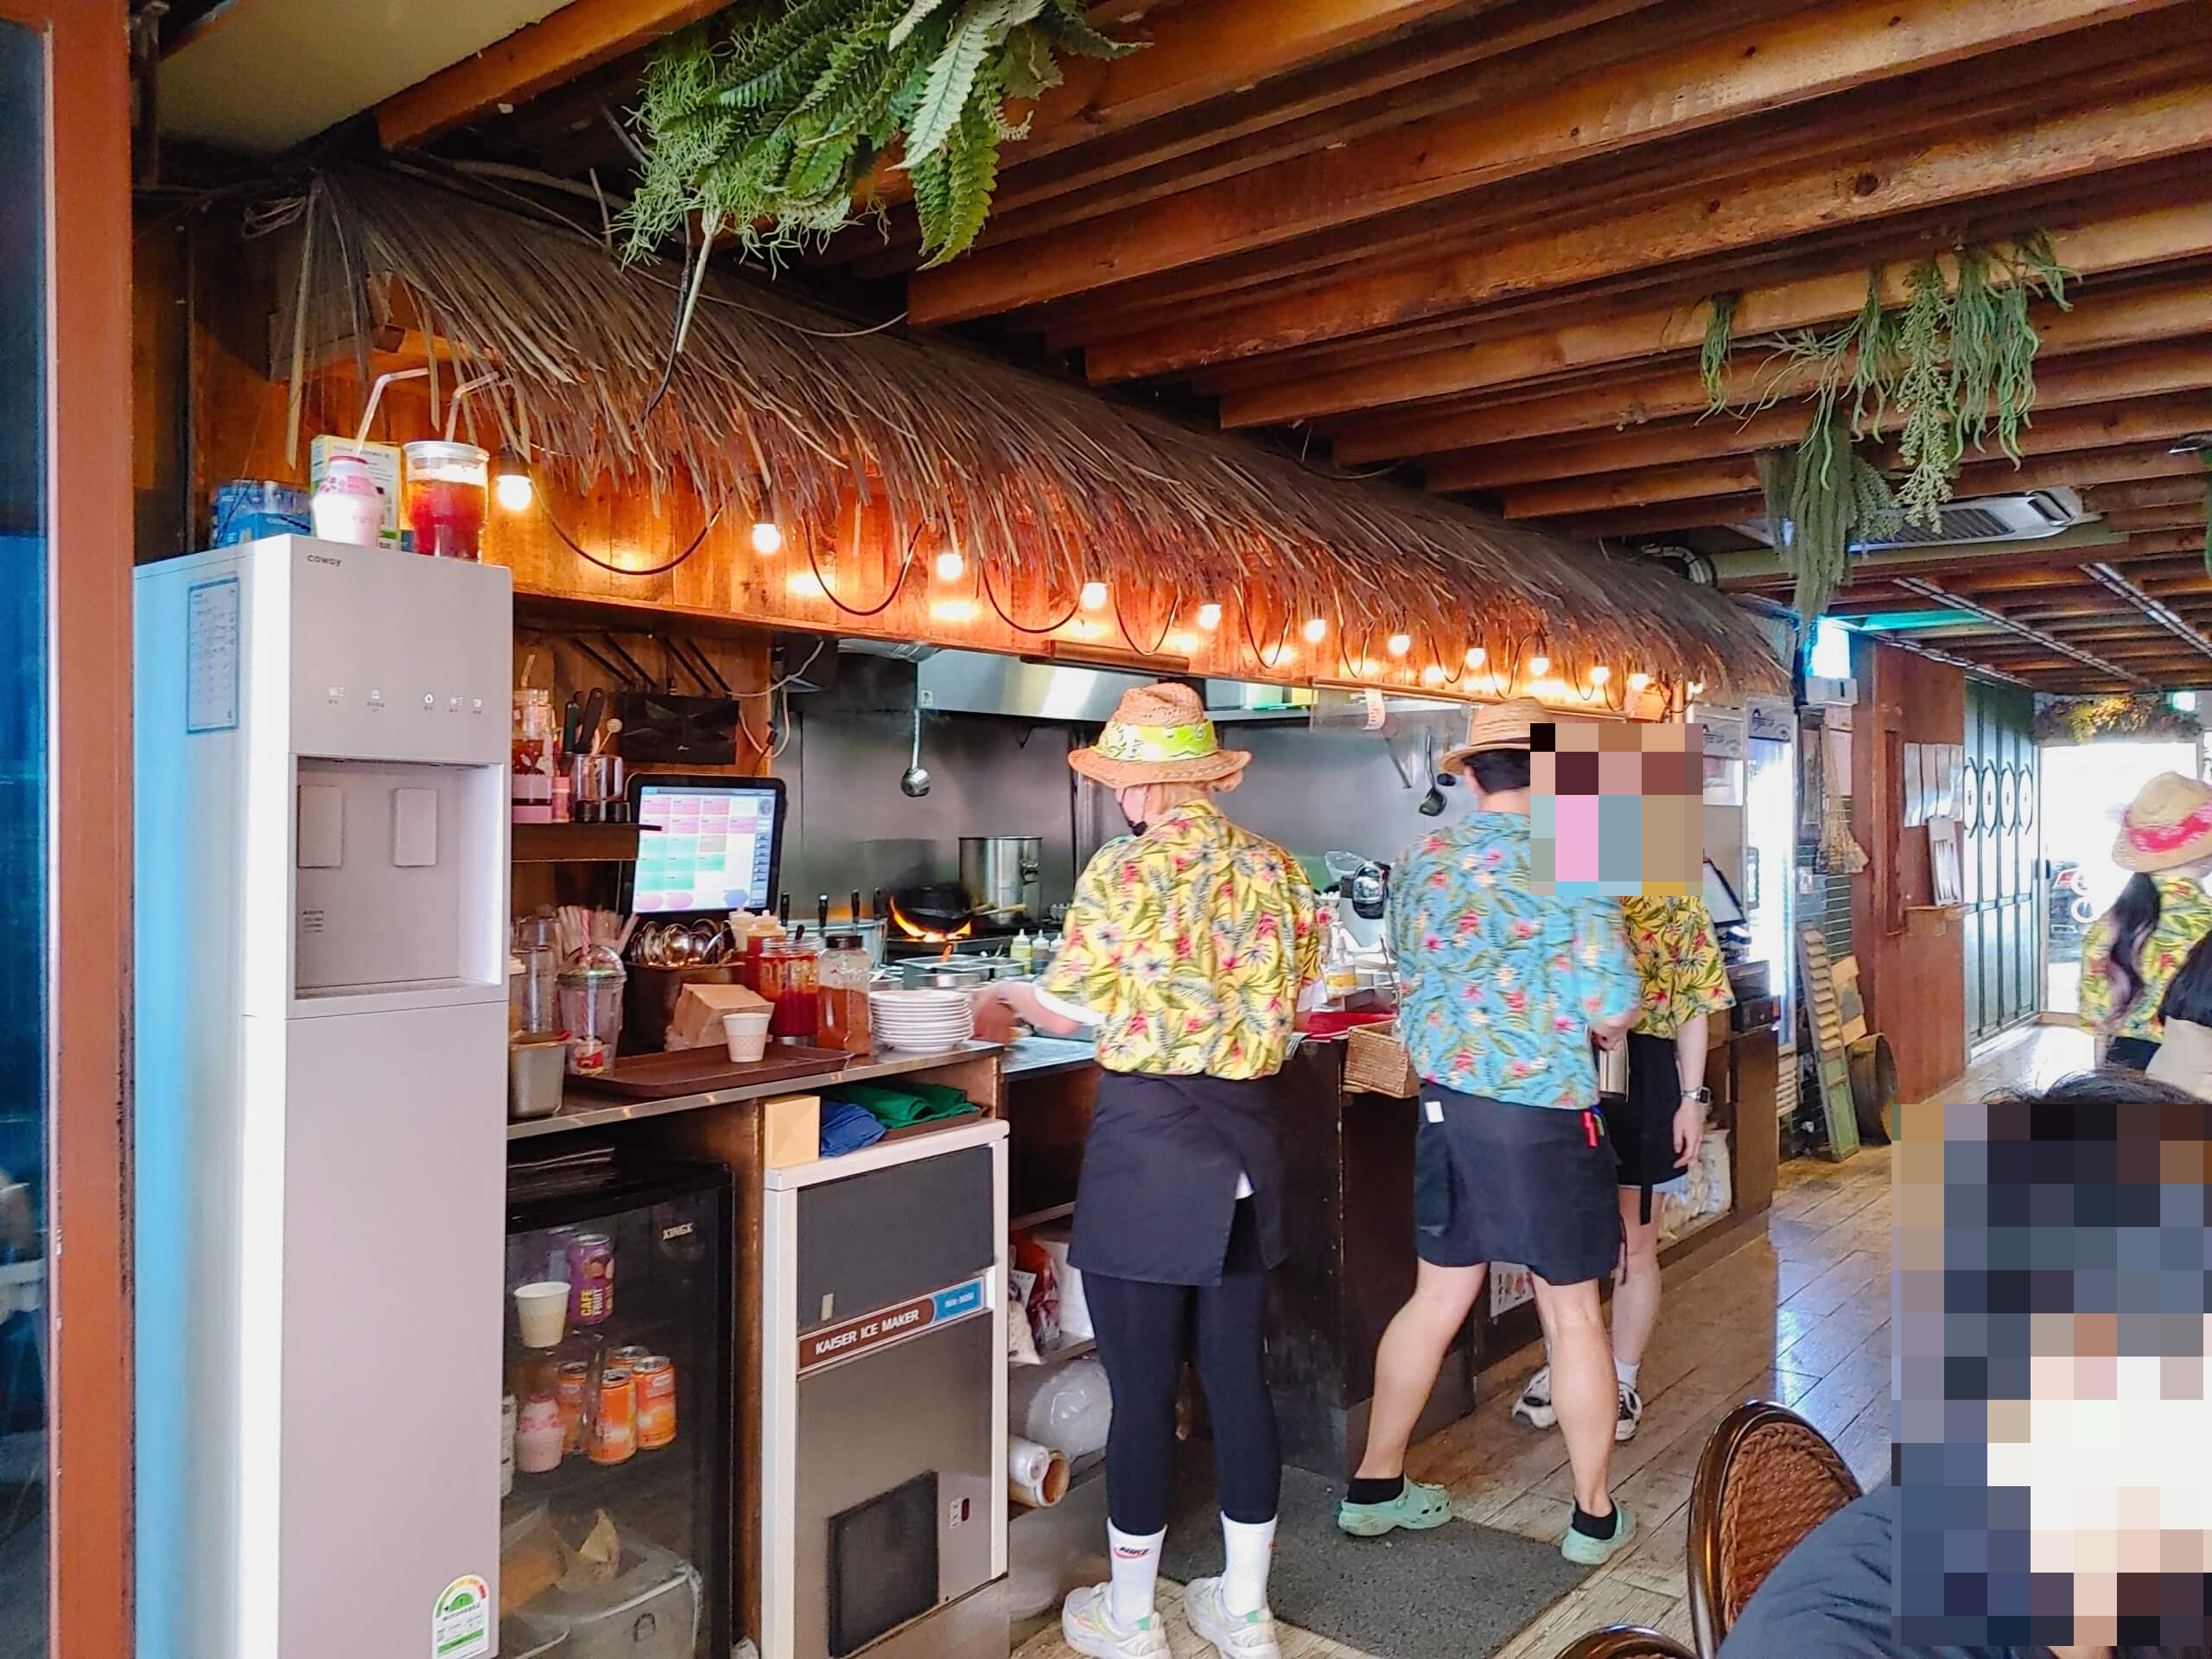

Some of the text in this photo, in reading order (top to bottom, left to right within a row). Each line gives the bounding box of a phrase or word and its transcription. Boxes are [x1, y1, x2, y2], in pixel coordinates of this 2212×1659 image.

[307, 554, 341, 567] coway
[580, 1288, 593, 1317] CAFE
[593, 1287, 603, 1315] FRUIT
[815, 1309, 919, 1355] KAISER ICE MAKER
